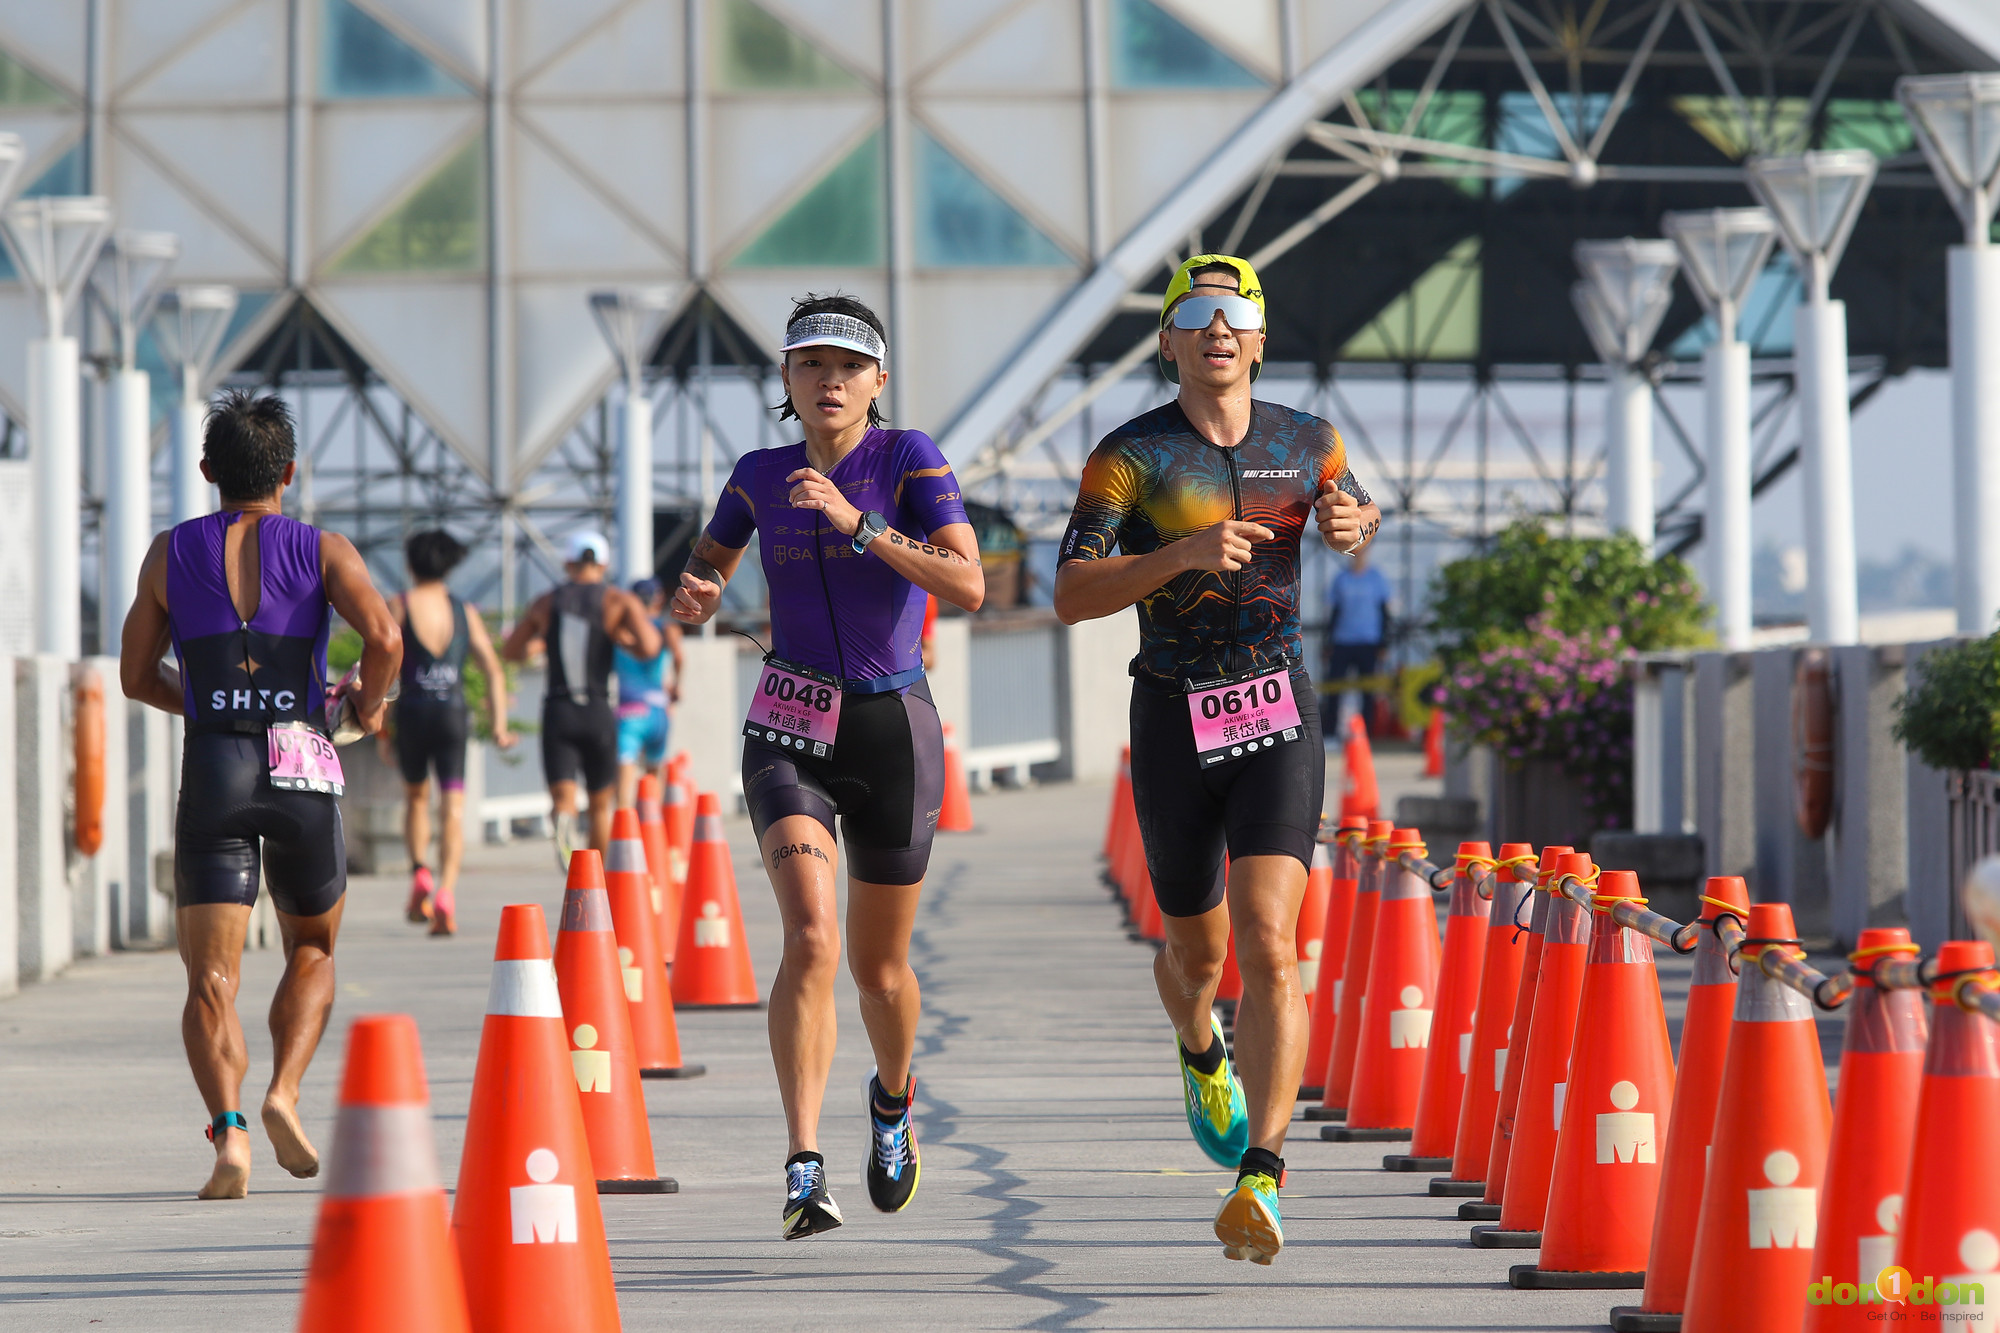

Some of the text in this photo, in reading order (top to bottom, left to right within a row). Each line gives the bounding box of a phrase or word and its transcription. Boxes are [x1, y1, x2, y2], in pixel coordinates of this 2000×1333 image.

[1258, 469, 1301, 479] ZOOT
[935, 492, 960, 504] PSI
[787, 546, 814, 561] GA
[764, 672, 833, 713] 0048
[1201, 678, 1282, 720] 0610
[773, 701, 798, 714] AKIWEI
[1224, 713, 1250, 725] AKIWEI
[1255, 708, 1266, 718] GF
[1222, 717, 1272, 743] 張岱偉
